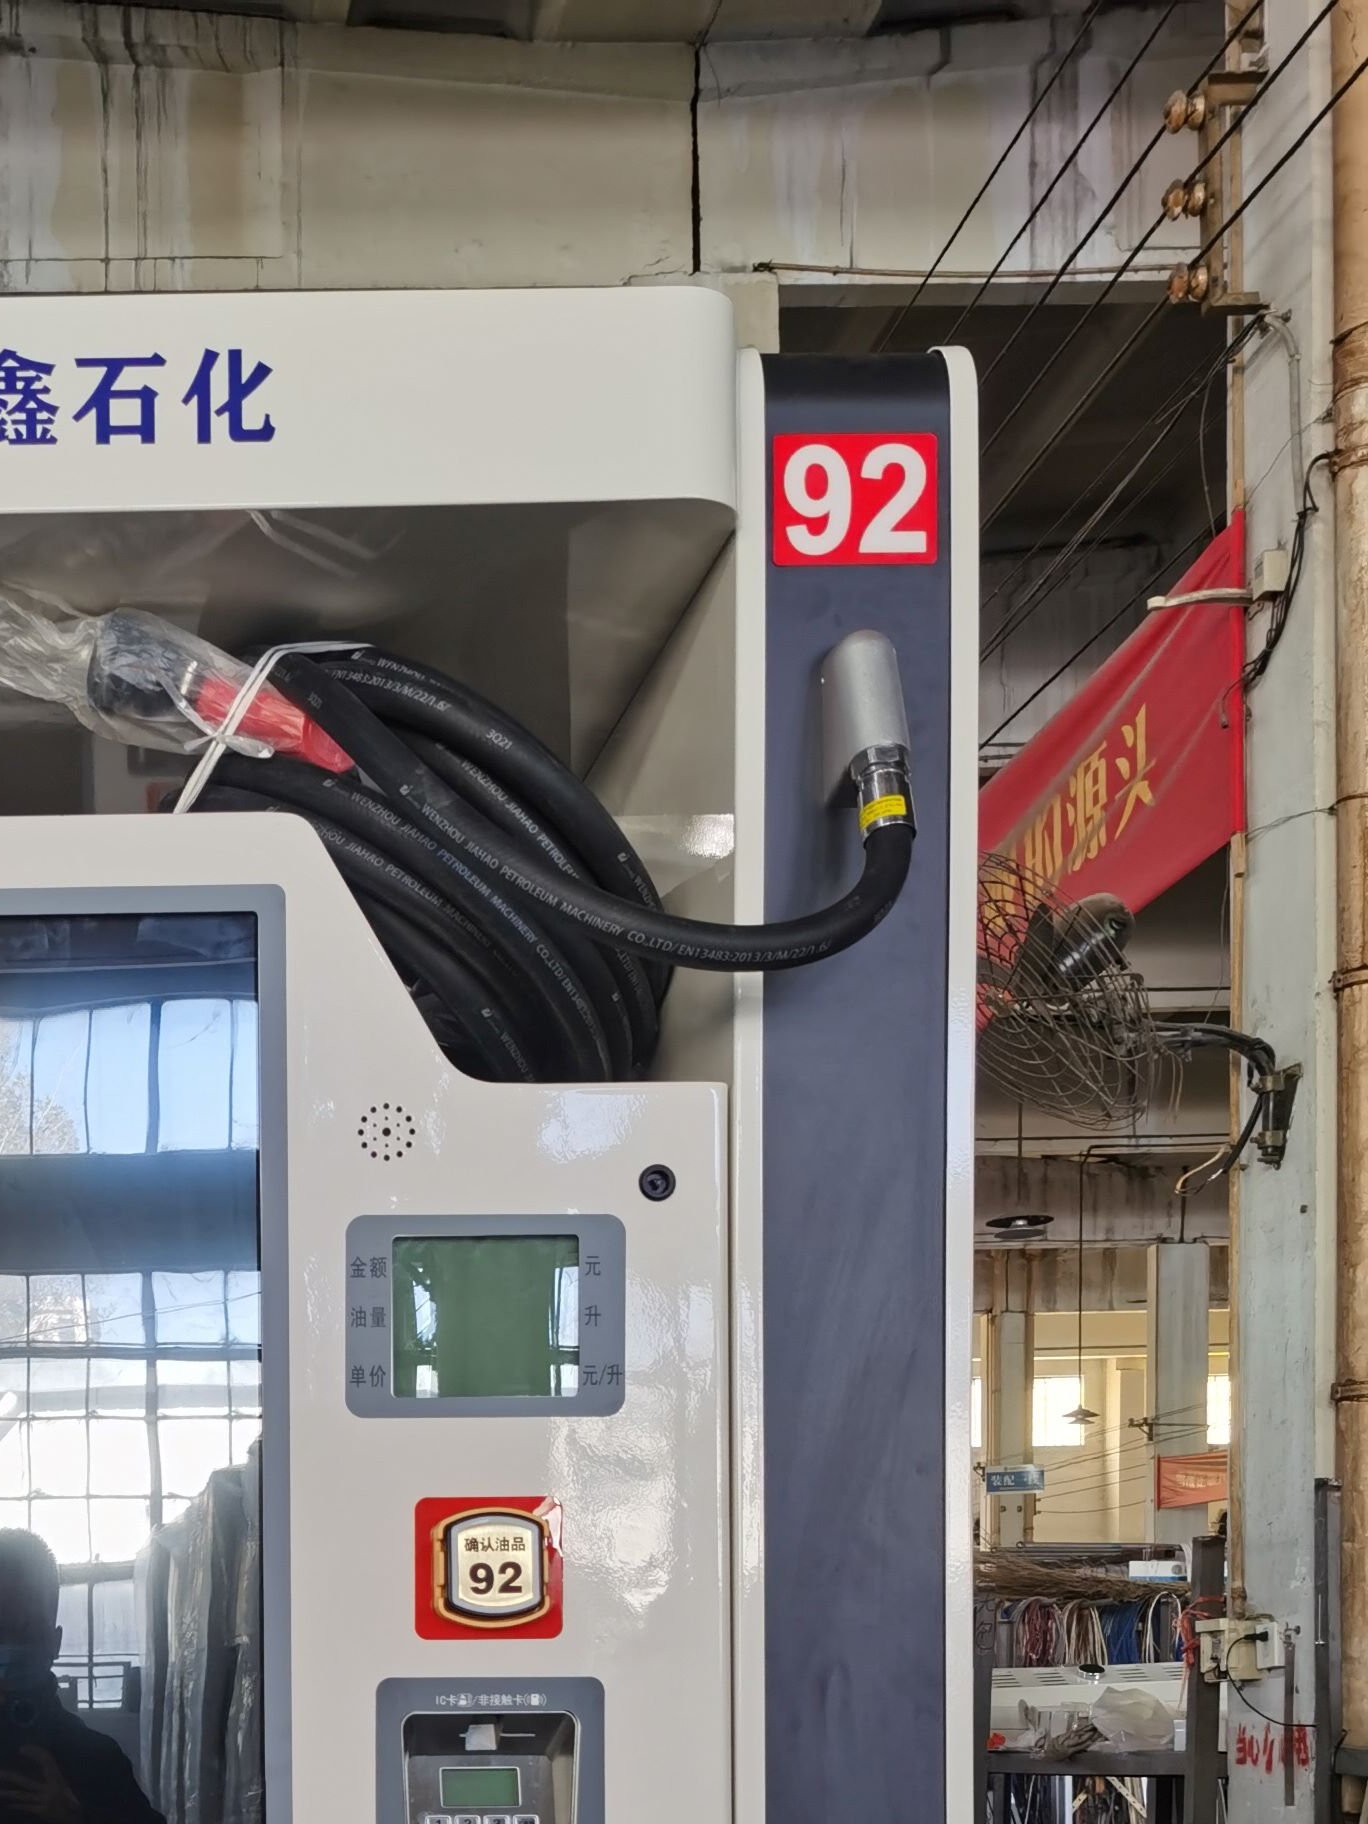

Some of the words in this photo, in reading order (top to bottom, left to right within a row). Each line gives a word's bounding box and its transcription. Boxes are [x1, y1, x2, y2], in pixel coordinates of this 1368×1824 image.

[783, 443, 927, 556] 92
[458, 757, 508, 802] WENZHOU
[503, 800, 538, 834] JIAHAO
[535, 833, 580, 879] PETROLE
[344, 840, 383, 867] JIAHAO
[384, 862, 443, 907] PETROLEUM
[350, 790, 401, 826] WENZHOU
[399, 822, 437, 851] JIAHAO
[435, 848, 492, 898] PETROLEUM
[490, 893, 538, 945] MACHINERY
[419, 801, 466, 845] WENZHOU
[463, 838, 499, 870] JIAHAO
[499, 863, 559, 906] PETROLEUM
[558, 901, 625, 937] MACHINERY
[349, 1255, 388, 1280] 金额
[585, 1255, 601, 1276] 元
[349, 1305, 387, 1329] 油量
[584, 1304, 602, 1327] 升
[349, 1364, 387, 1389] 单价
[582, 1363, 623, 1387] 元/升
[463, 1536, 526, 1552] 确认油品
[469, 1561, 523, 1595] 92
